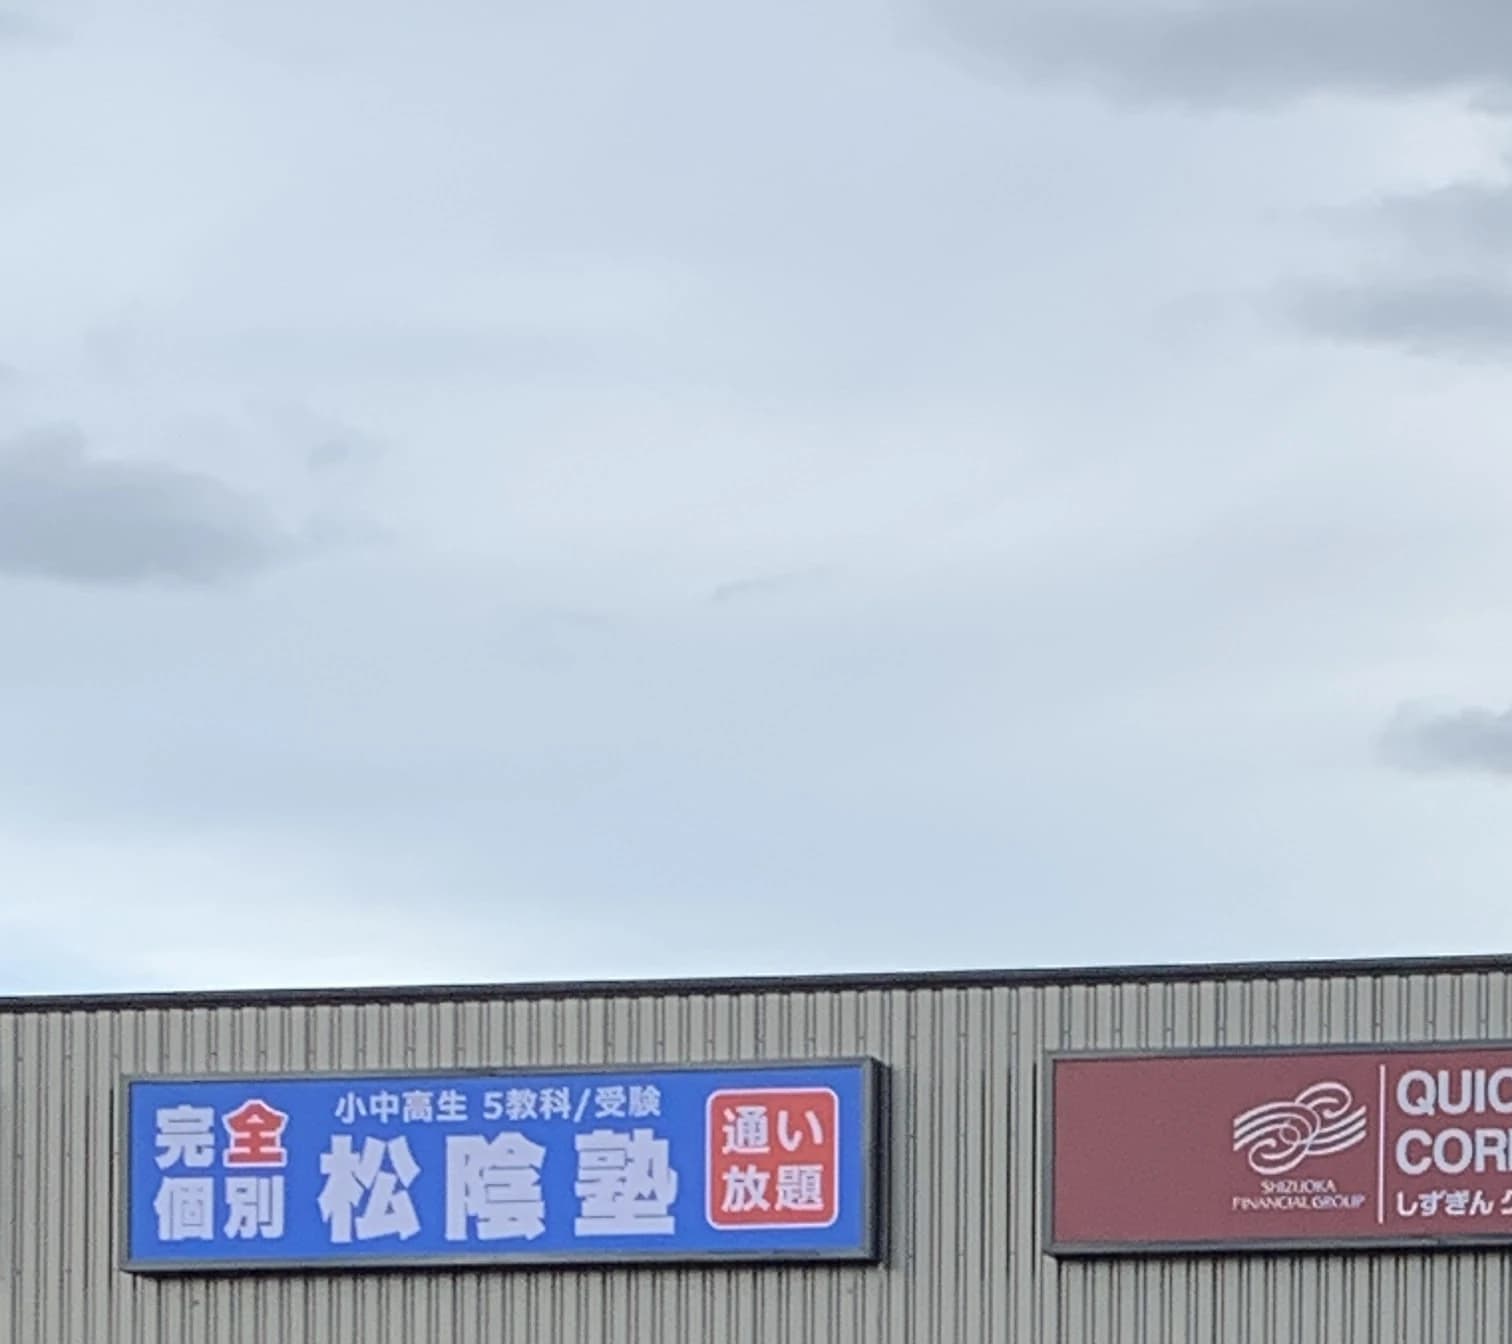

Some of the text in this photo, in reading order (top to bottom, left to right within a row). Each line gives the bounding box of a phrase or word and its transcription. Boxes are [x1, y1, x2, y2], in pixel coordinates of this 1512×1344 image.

[334, 1084, 662, 1124] 小中高生 5教科/受験
[155, 1098, 289, 1170] 完全
[720, 1104, 824, 1155] 通い
[153, 1174, 286, 1241] 個別
[316, 1129, 678, 1243] 松陰塾
[719, 1163, 825, 1213] 放題
[1232, 1193, 1366, 1211] FINANCIAL GROUP
[1259, 1178, 1337, 1195] SHIZUOKA
[1396, 1189, 1494, 1218] しずぎん
